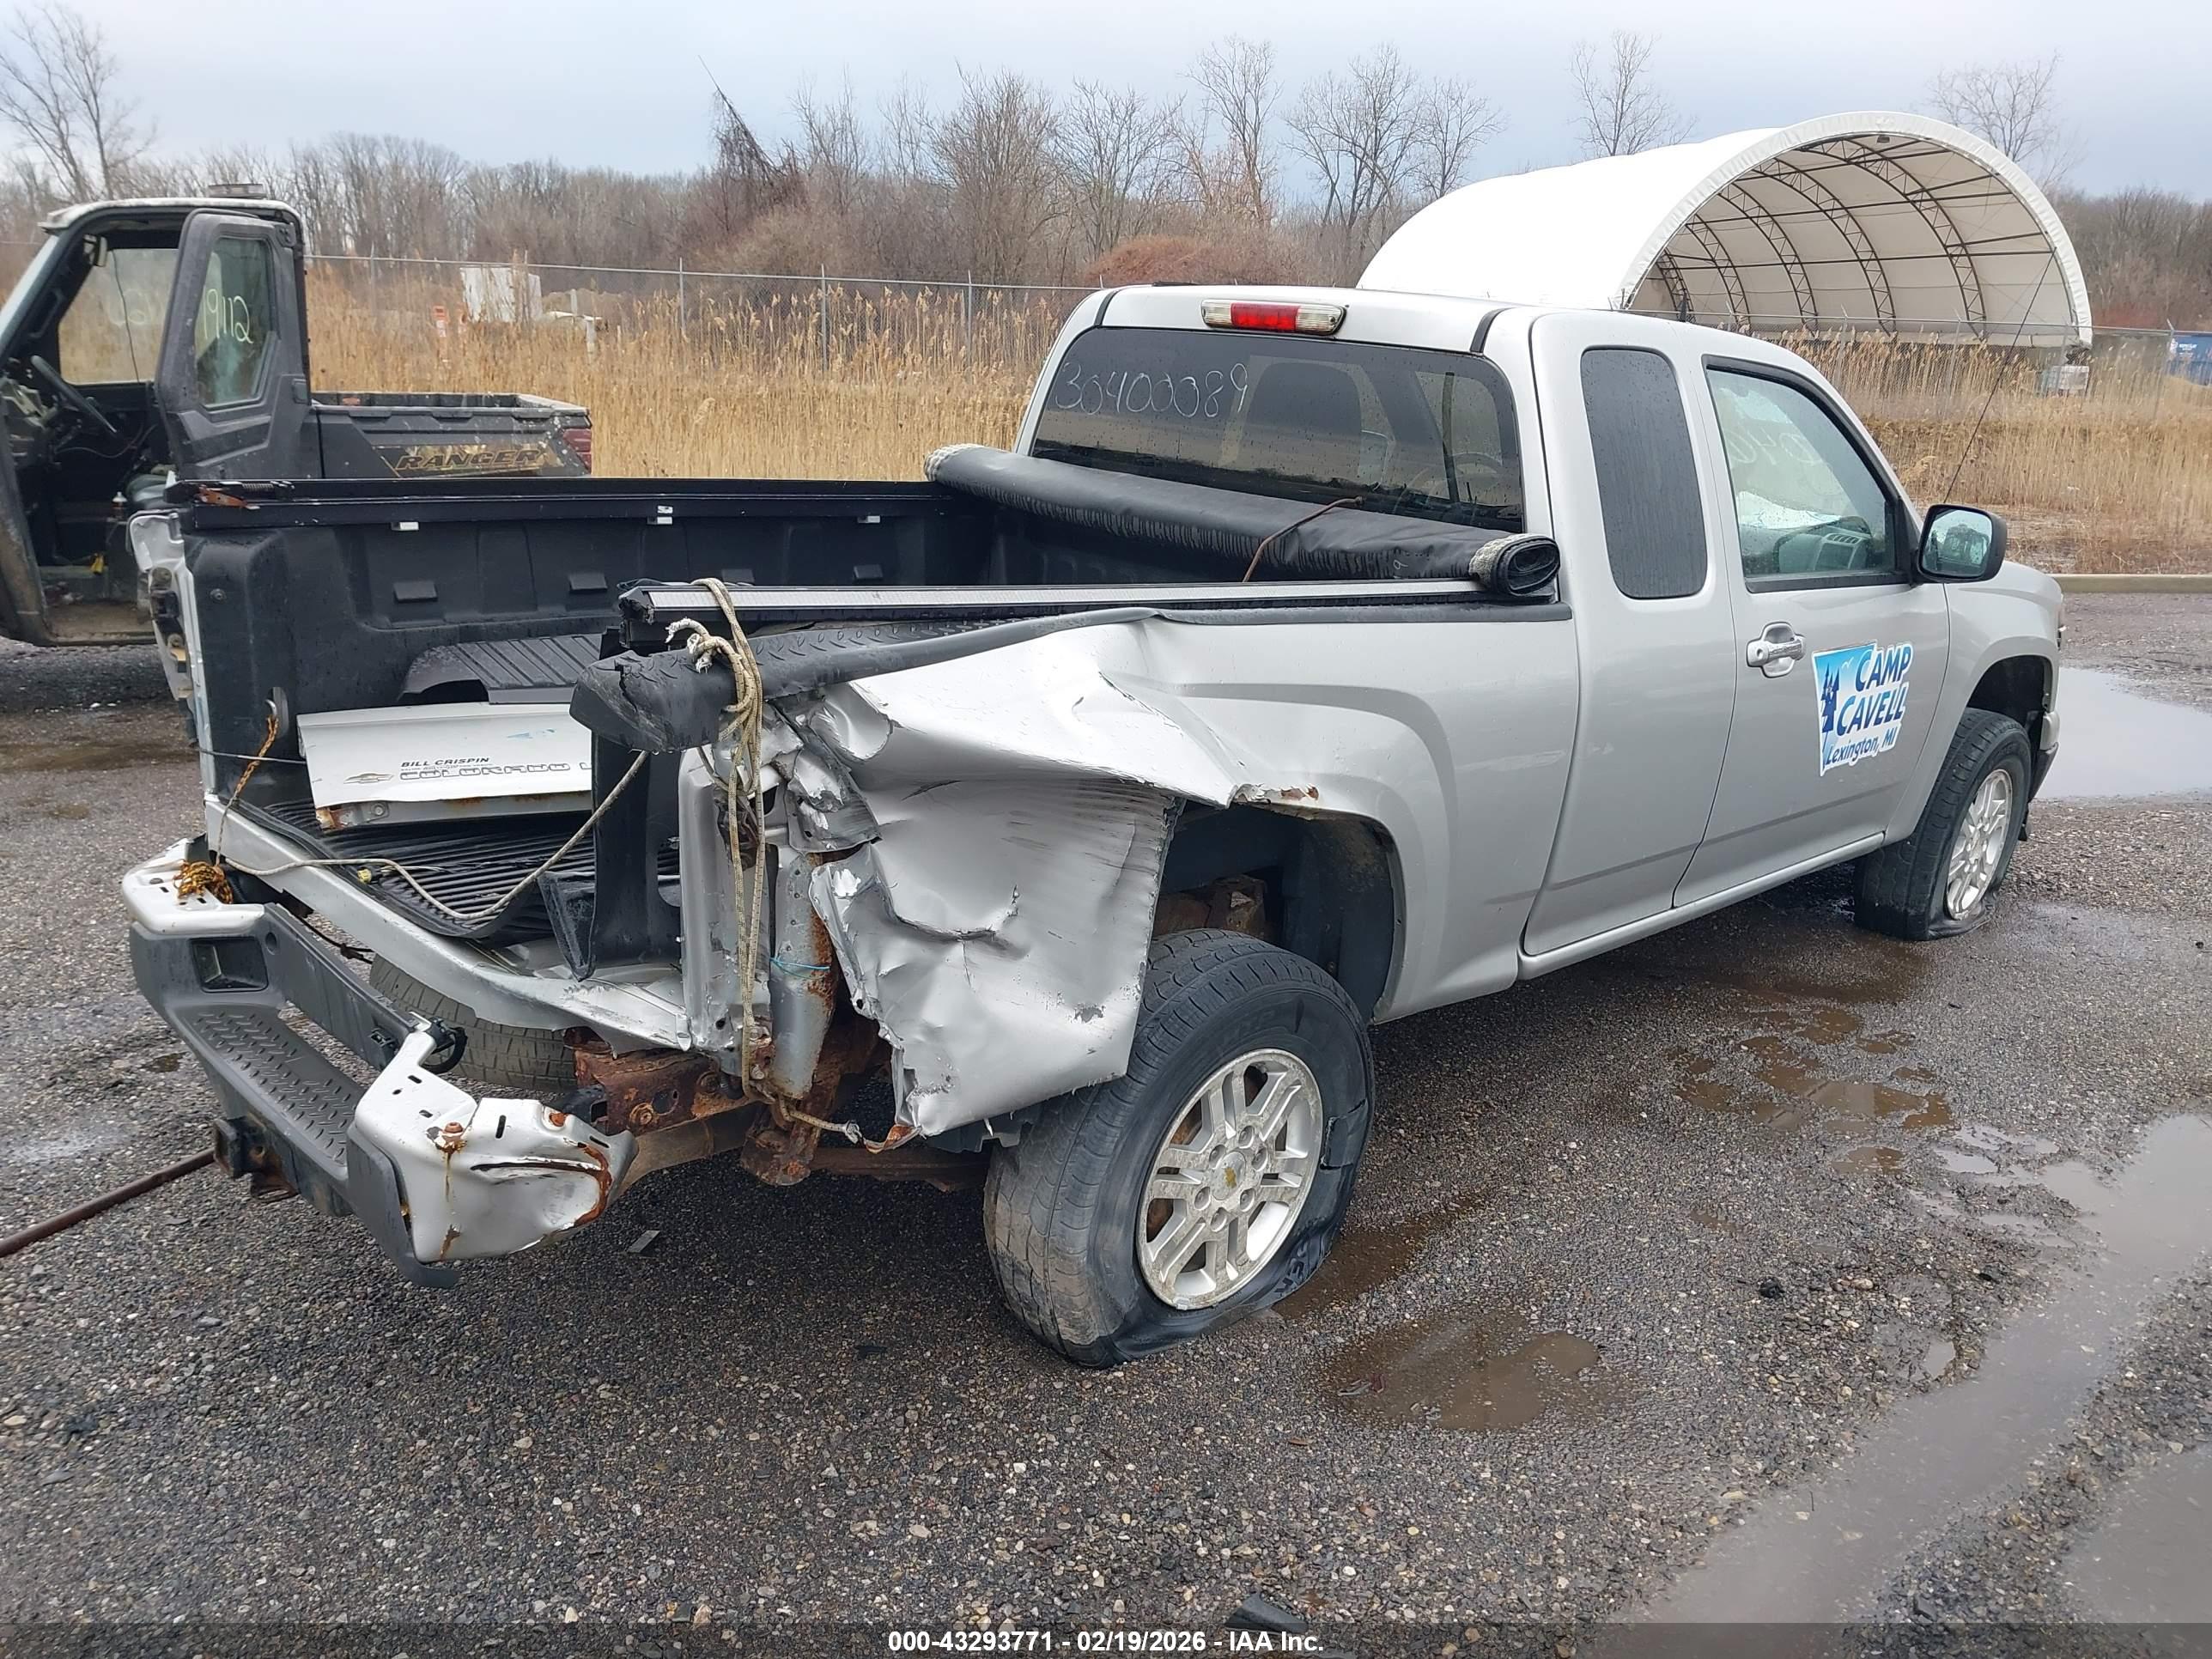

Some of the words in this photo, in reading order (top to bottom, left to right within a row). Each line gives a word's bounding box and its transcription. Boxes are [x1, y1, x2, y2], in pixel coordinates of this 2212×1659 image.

[1054, 362, 1249, 419] 30400089
[394, 449, 543, 471] RANGER
[1855, 645, 1912, 693] CAMP
[1836, 686, 1908, 737] CAVELL
[434, 757, 490, 766] CRISPIN
[1825, 736, 1880, 766] Lexington,
[1881, 726, 1899, 749] MI
[400, 763, 571, 781] COLORADO
